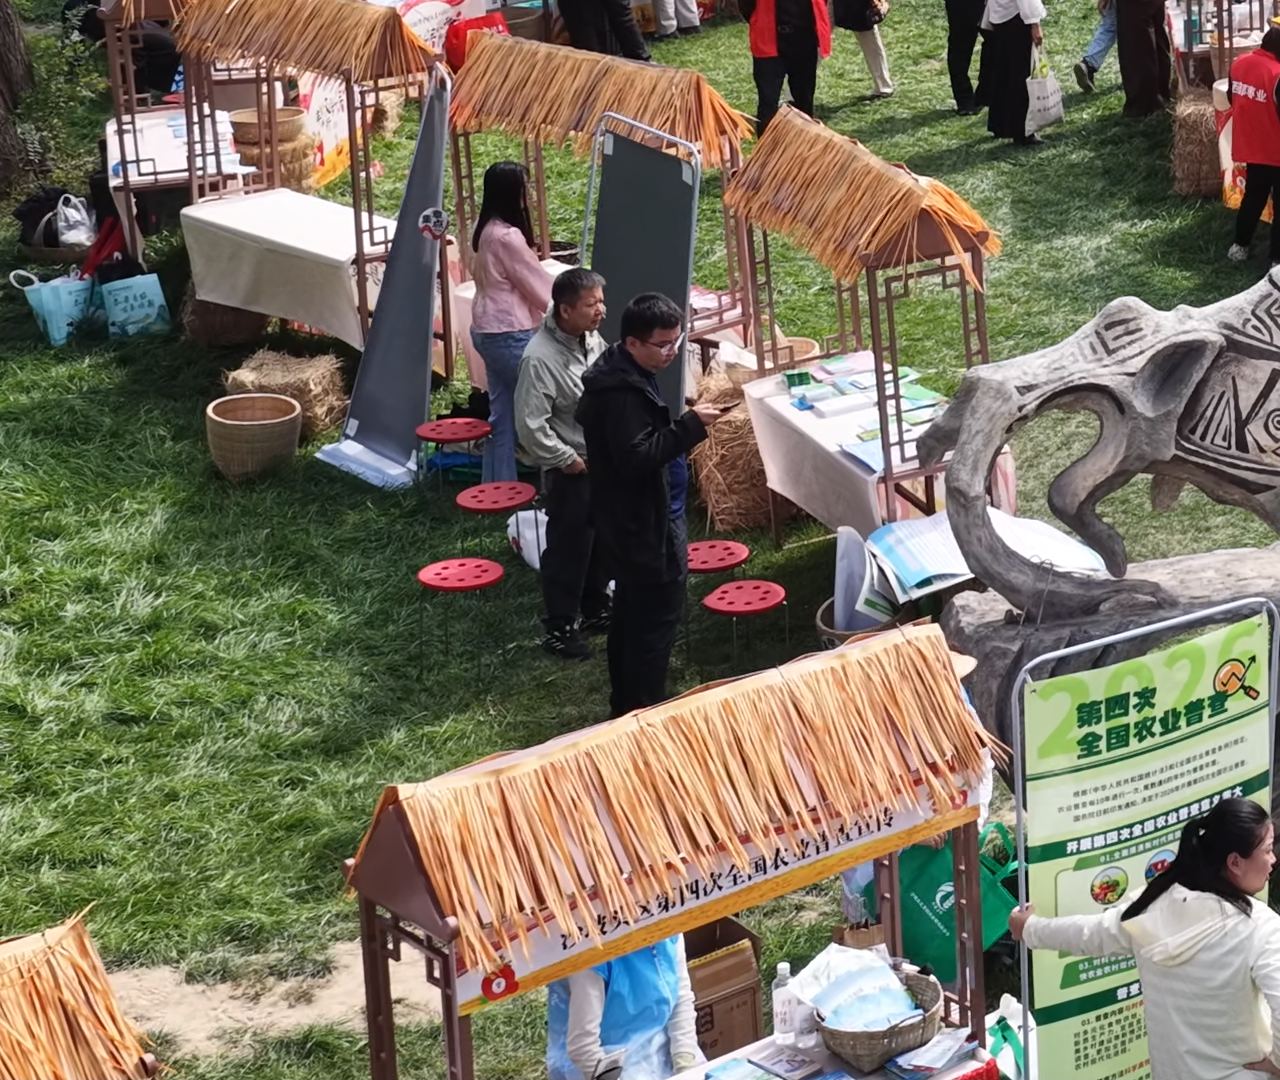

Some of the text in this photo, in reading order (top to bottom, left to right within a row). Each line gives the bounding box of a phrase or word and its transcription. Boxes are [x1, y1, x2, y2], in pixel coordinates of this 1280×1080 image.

[1076, 685, 1157, 729] 第四次
[1076, 690, 1229, 760] 全国农业普查
